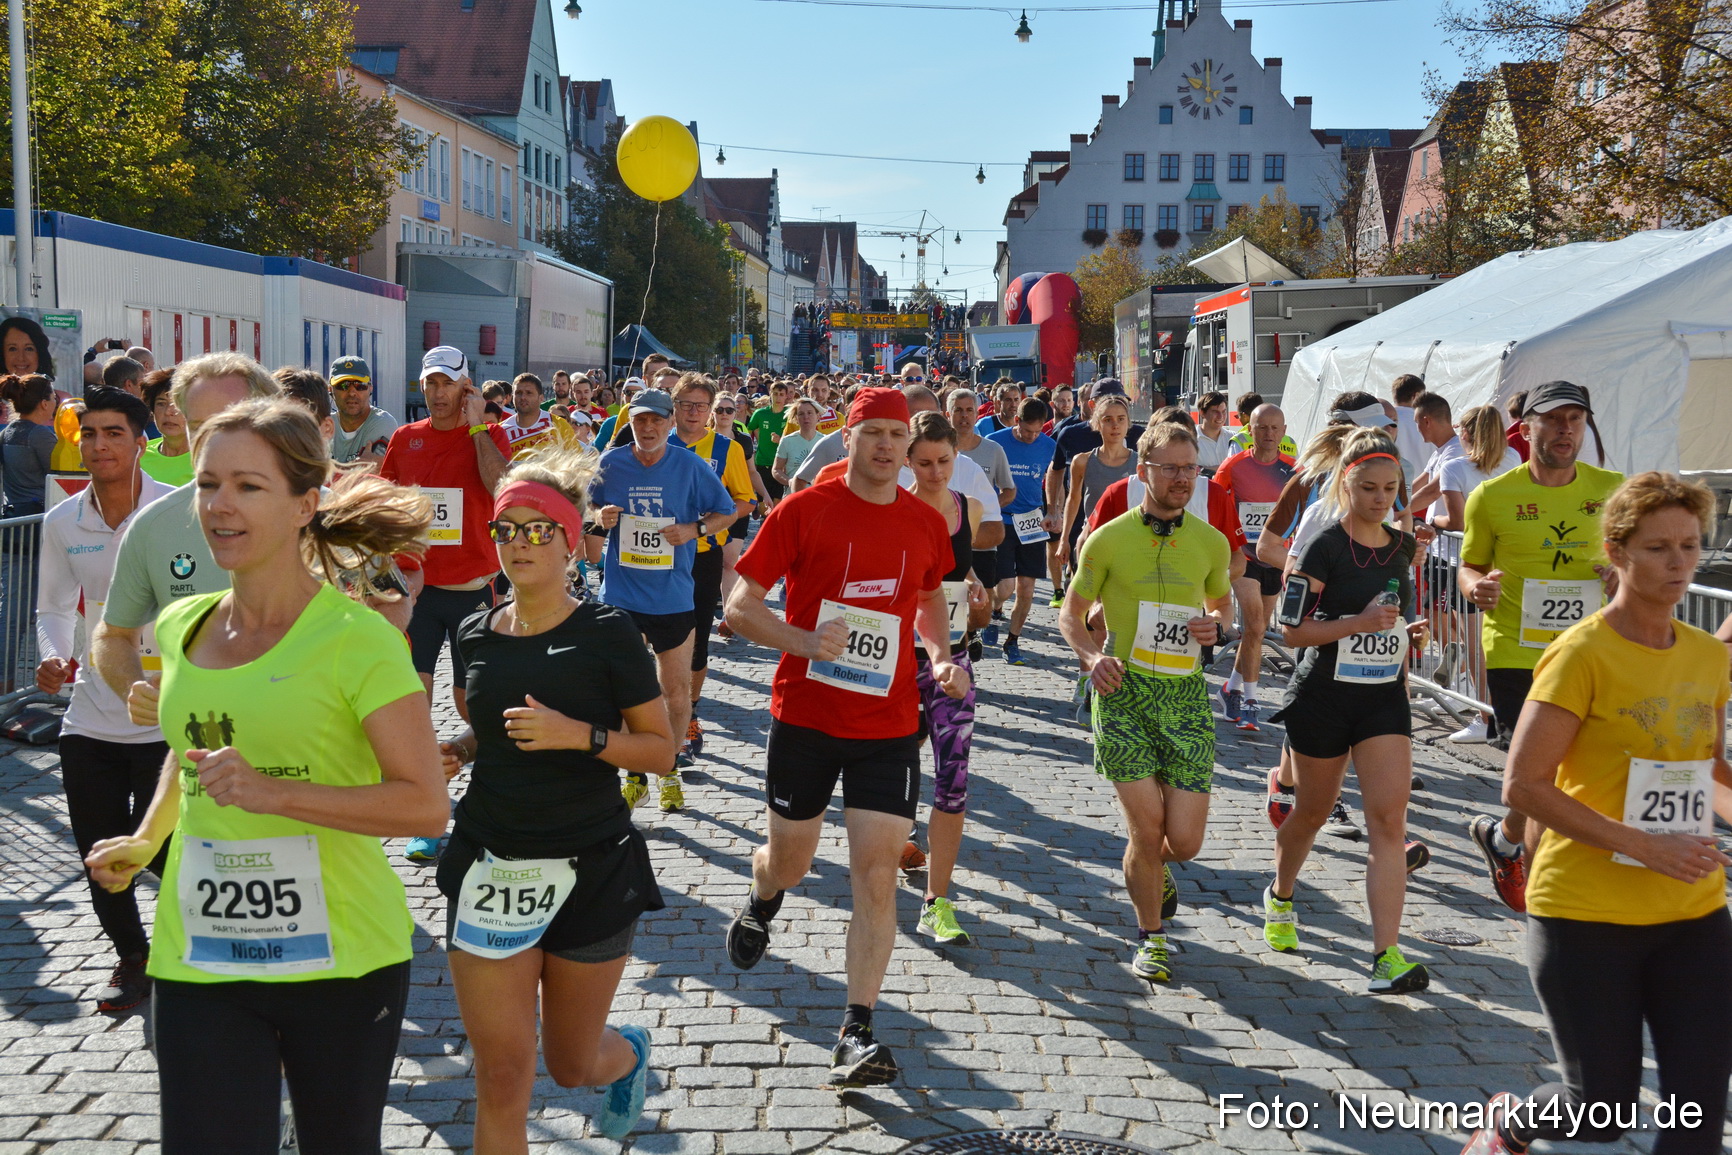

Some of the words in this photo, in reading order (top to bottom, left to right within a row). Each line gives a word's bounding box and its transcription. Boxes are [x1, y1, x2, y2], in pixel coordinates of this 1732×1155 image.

[862, 316, 896, 324] START
[1516, 503, 1538, 515] 15
[632, 531, 660, 548] 165
[66, 544, 104, 555] Waitrose
[631, 556, 660, 564] Reinhard
[858, 584, 883, 593] DEHN
[1542, 600, 1584, 620] 223
[844, 613, 881, 628] BOCK
[1154, 622, 1189, 646] 343
[1350, 633, 1399, 655] 2038
[848, 658, 872, 668] Neumarkt
[833, 666, 868, 684] Robert
[1362, 667, 1384, 676] Laura
[1640, 790, 1704, 822] 2516
[214, 852, 273, 868] BOCK
[492, 867, 542, 880] BOCK
[197, 878, 301, 919] 2295
[474, 884, 556, 916] 2154
[212, 924, 239, 933] PARTL
[240, 924, 284, 933] Neumarkt
[479, 917, 503, 926] PARTL
[487, 932, 529, 947] Verena
[231, 942, 283, 960] Nicole
